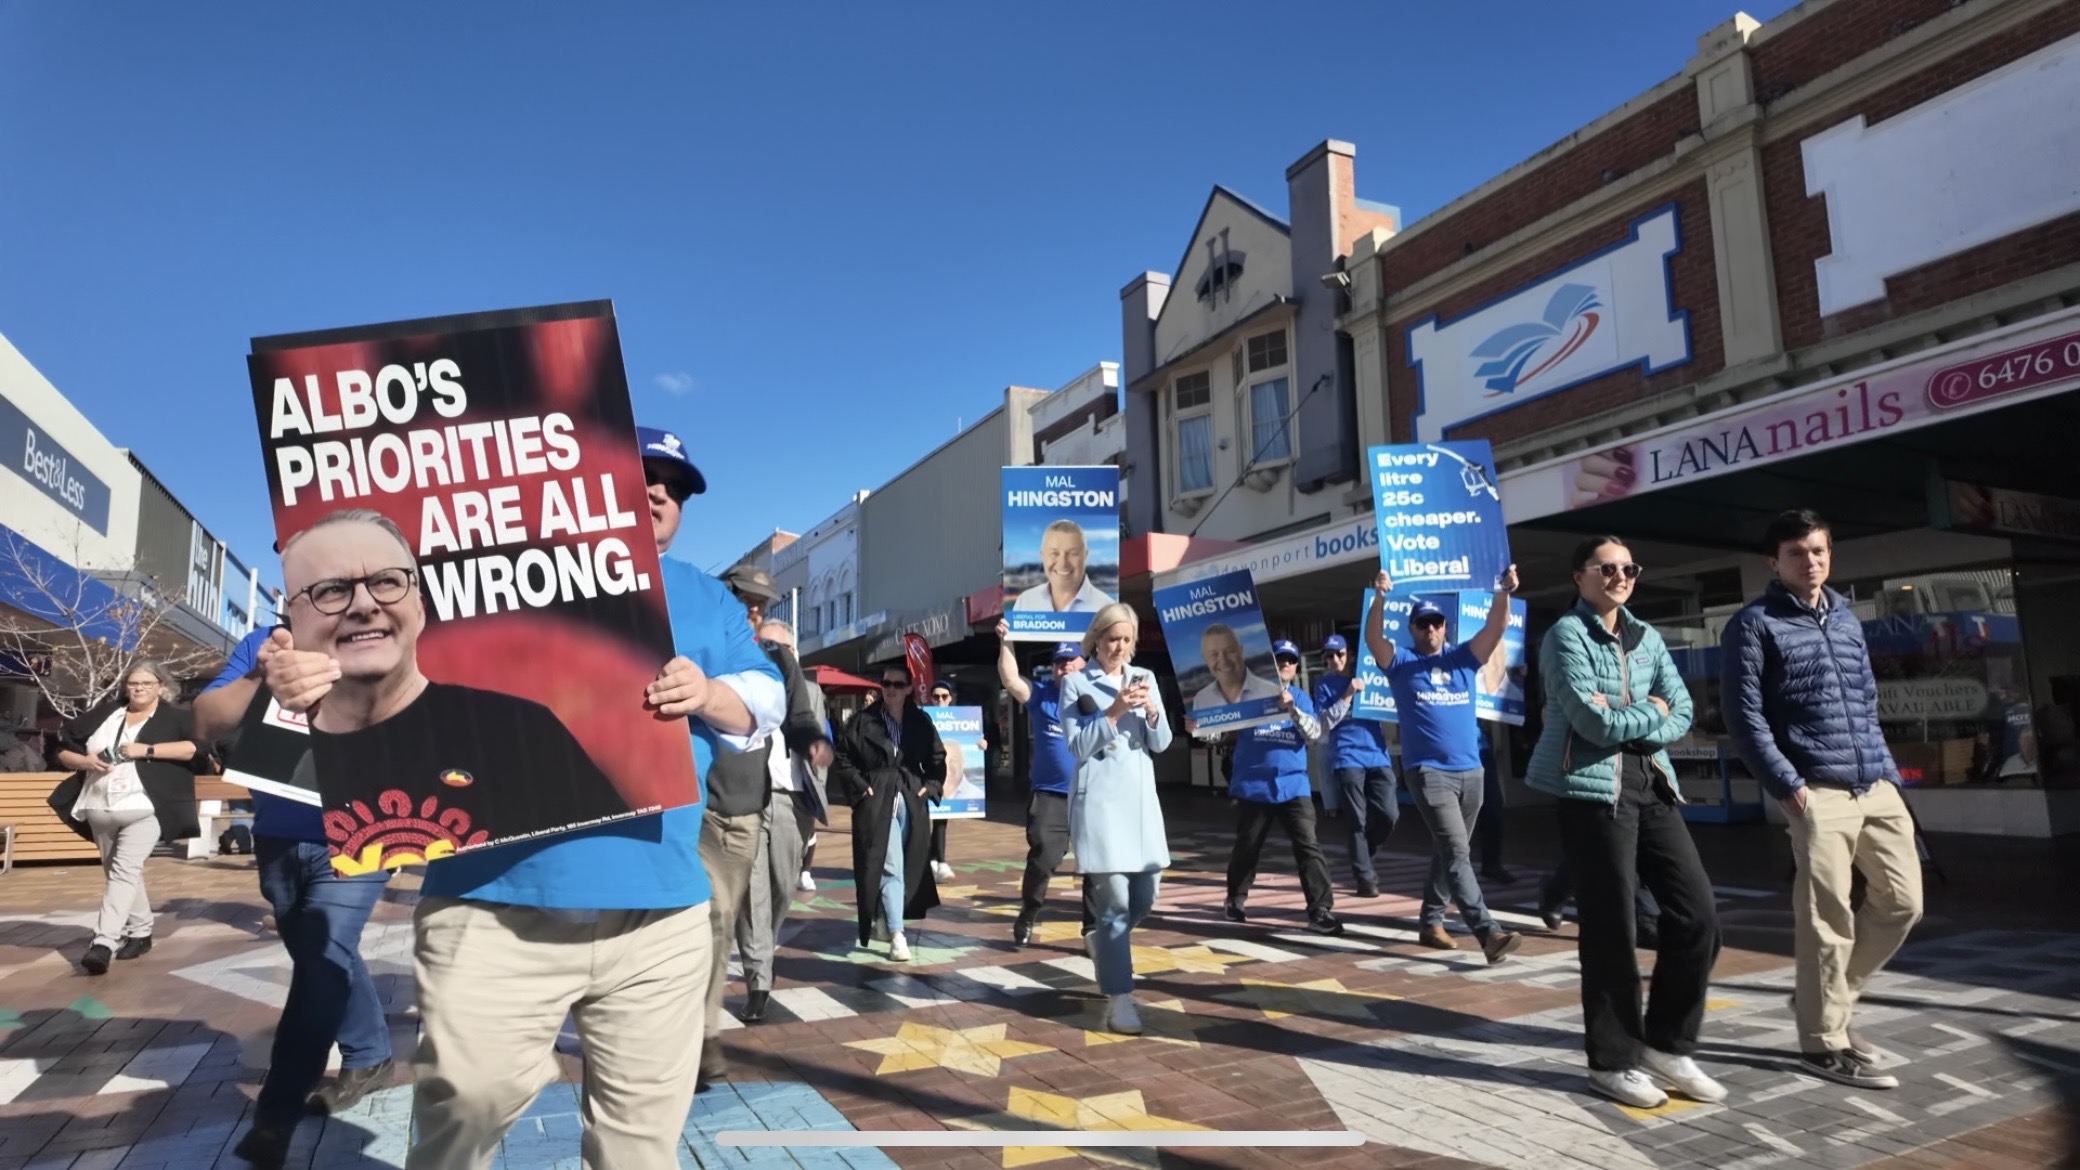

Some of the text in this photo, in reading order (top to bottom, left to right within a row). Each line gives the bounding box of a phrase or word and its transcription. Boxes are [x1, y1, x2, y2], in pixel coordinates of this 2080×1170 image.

[1977, 349, 2054, 389] 6476
[270, 358, 467, 439] ALBO'S
[1650, 381, 1904, 484] LANA nails
[275, 412, 580, 506] PRIORITIES
[1377, 453, 1439, 467] Every
[24, 428, 85, 510] Best&Less
[1045, 476, 1076, 488] MAL
[1379, 472, 1423, 487] litre
[1008, 491, 1114, 507] HINGSTON
[1383, 491, 1424, 507] 25c
[419, 473, 636, 557] ARE ALL
[1385, 511, 1482, 528] cheaper.
[1387, 534, 1440, 551] Vote
[1390, 556, 1470, 577] Liberal
[421, 537, 651, 621] WRONG.
[1189, 585, 1217, 600] MAL
[1162, 590, 1254, 623] HINGSTON
[1370, 595, 1414, 617] very
[1013, 620, 1066, 630] BRADDON
[1362, 672, 1390, 688] Vot
[1360, 691, 1395, 707] Libe
[935, 720, 980, 731] GSTON
[532, 827, 551, 837] Liberal
